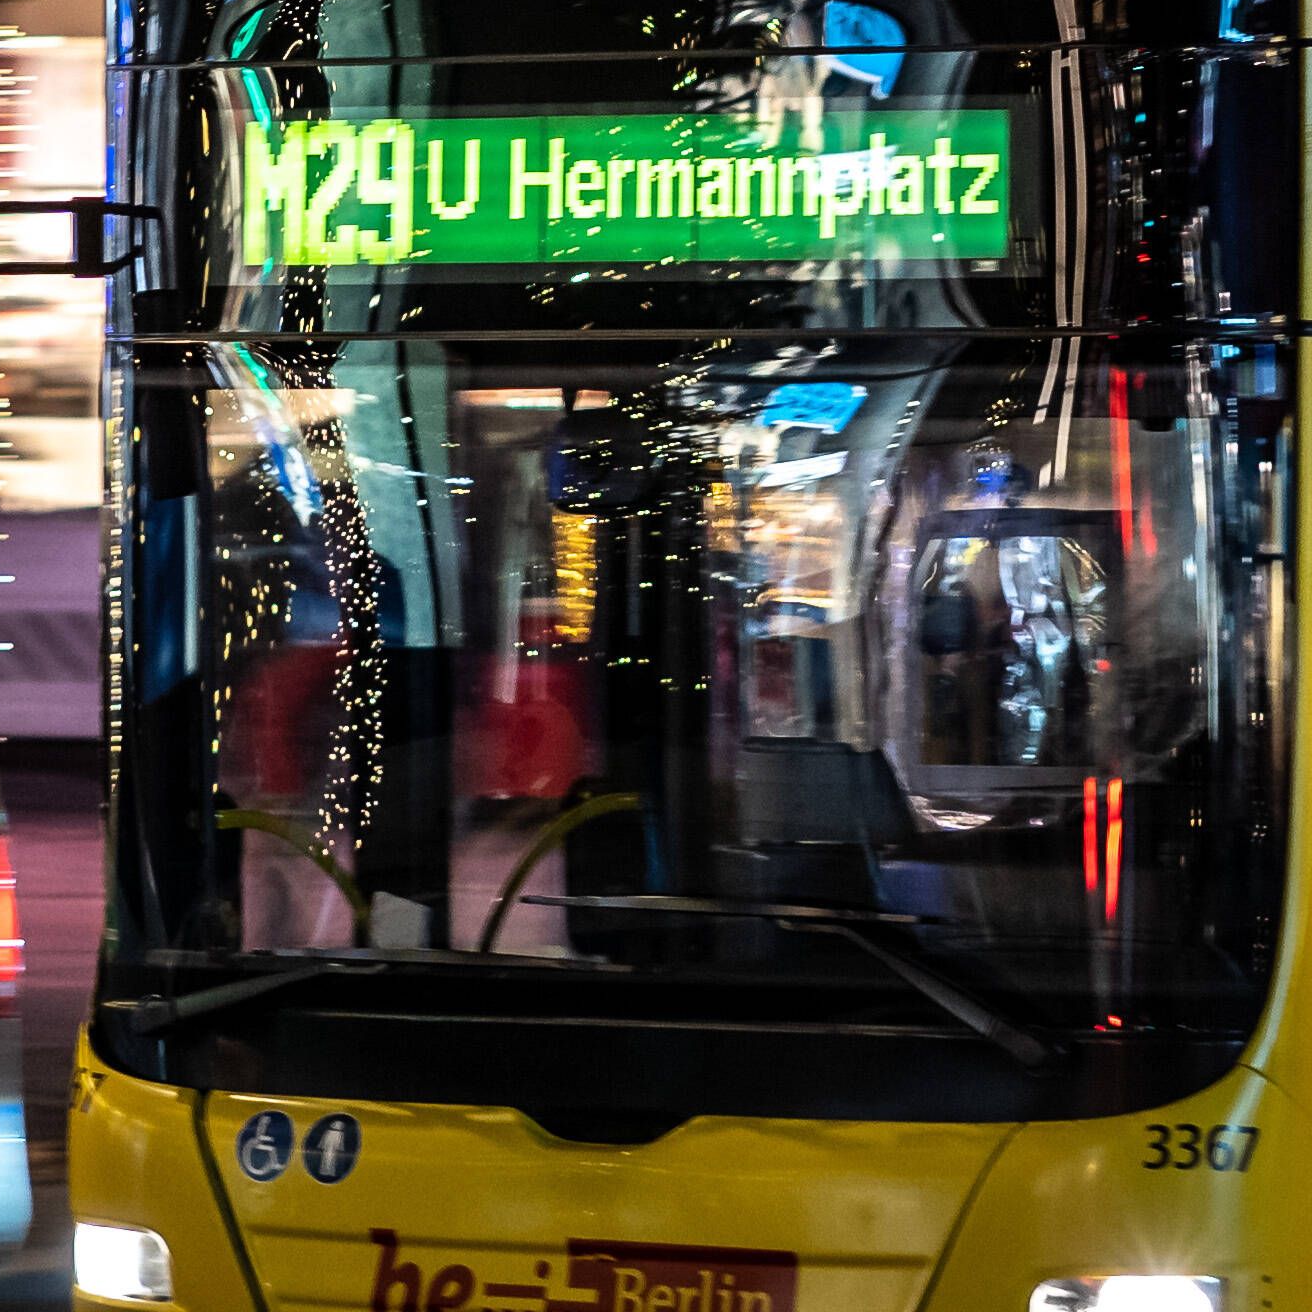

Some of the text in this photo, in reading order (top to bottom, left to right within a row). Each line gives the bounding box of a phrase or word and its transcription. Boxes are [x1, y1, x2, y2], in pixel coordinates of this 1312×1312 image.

[244, 119, 1000, 265] M29 U Hermannplatz
[1142, 1123, 1260, 1172] 3367
[613, 1266, 774, 1312] Berlin
